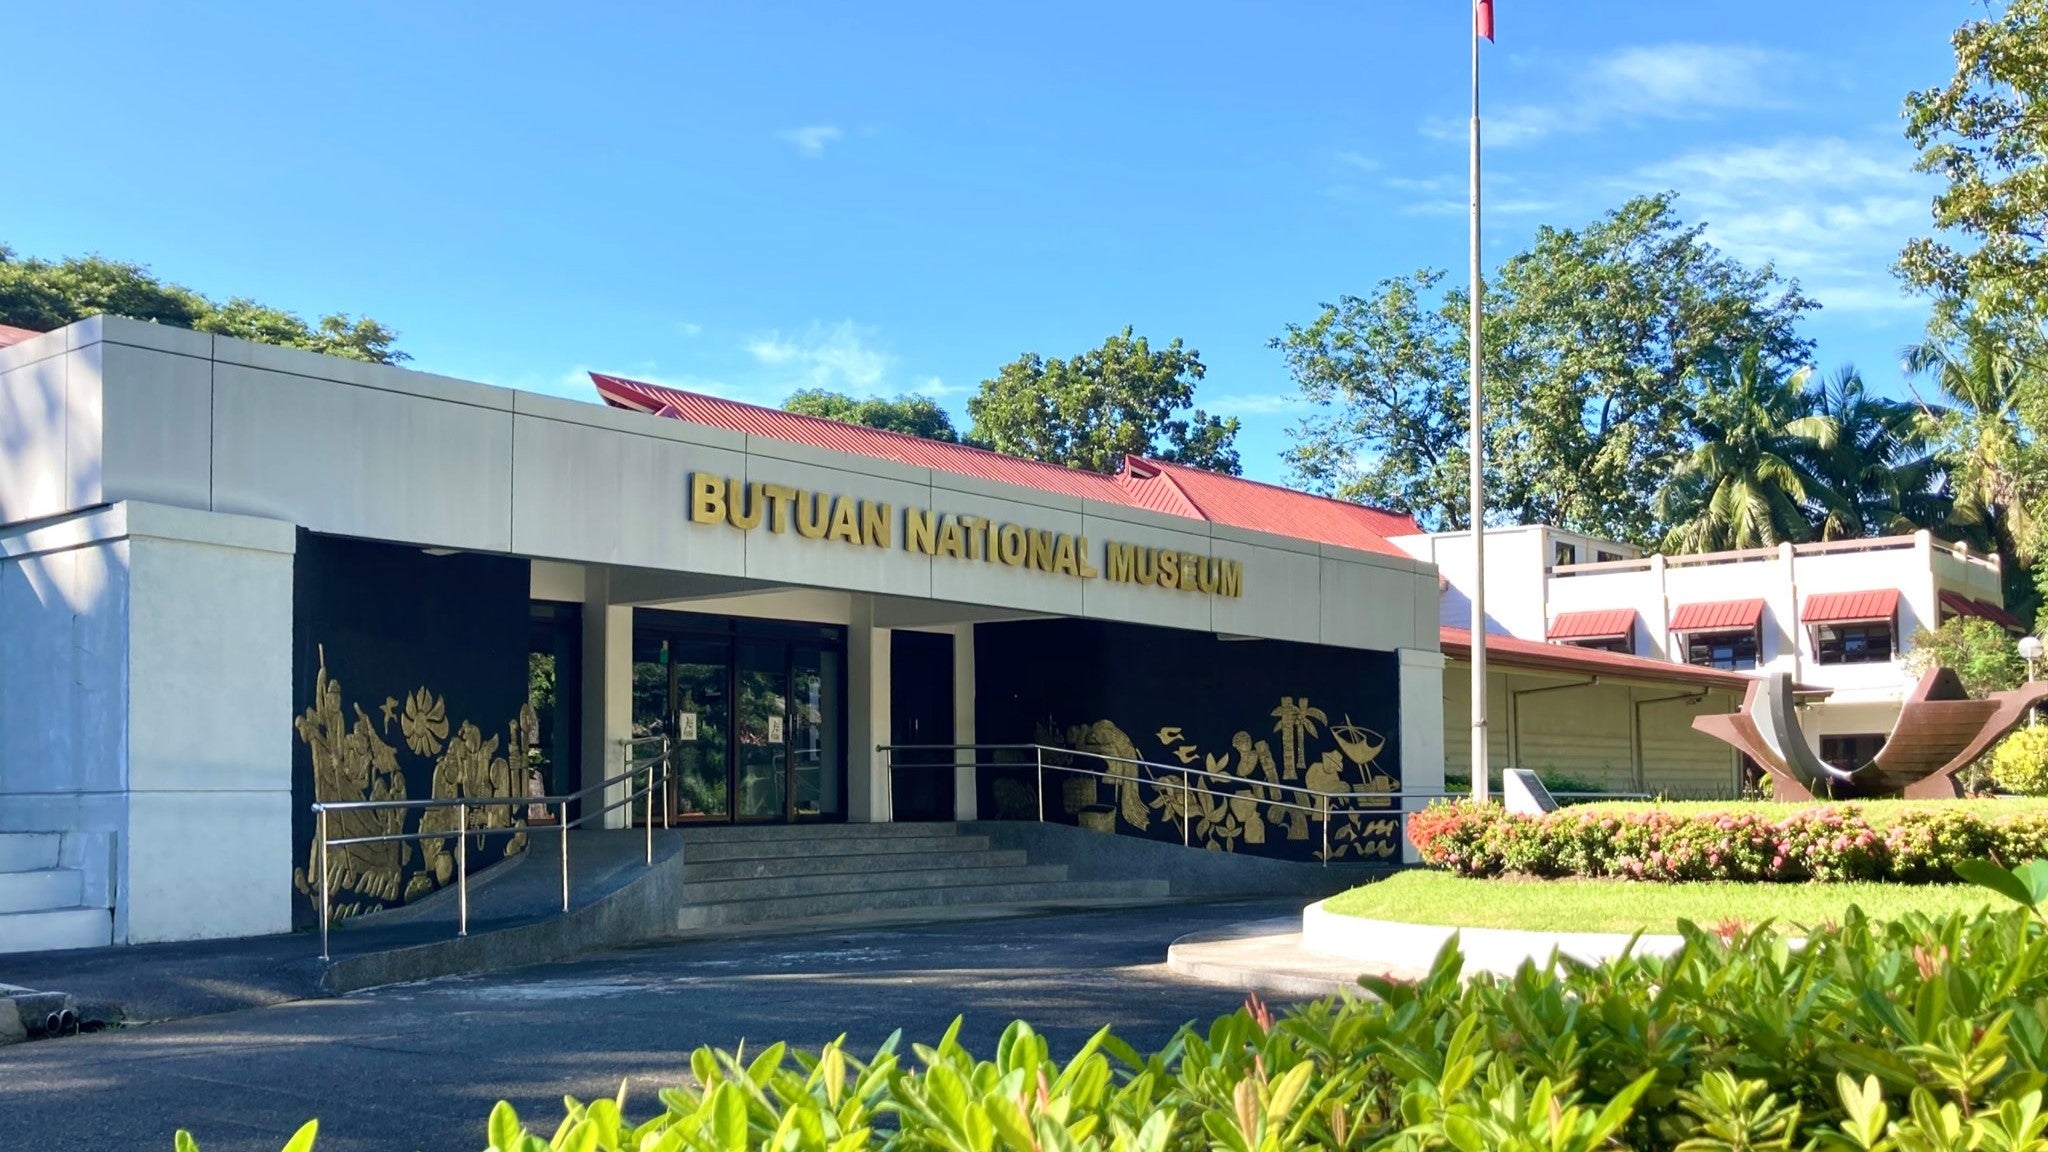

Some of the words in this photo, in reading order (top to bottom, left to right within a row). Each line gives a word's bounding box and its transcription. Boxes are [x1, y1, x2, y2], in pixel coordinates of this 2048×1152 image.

[690, 472, 892, 549] BUTUAN
[905, 506, 1098, 579] NATIONAL
[1107, 541, 1243, 598] MUSEUM
